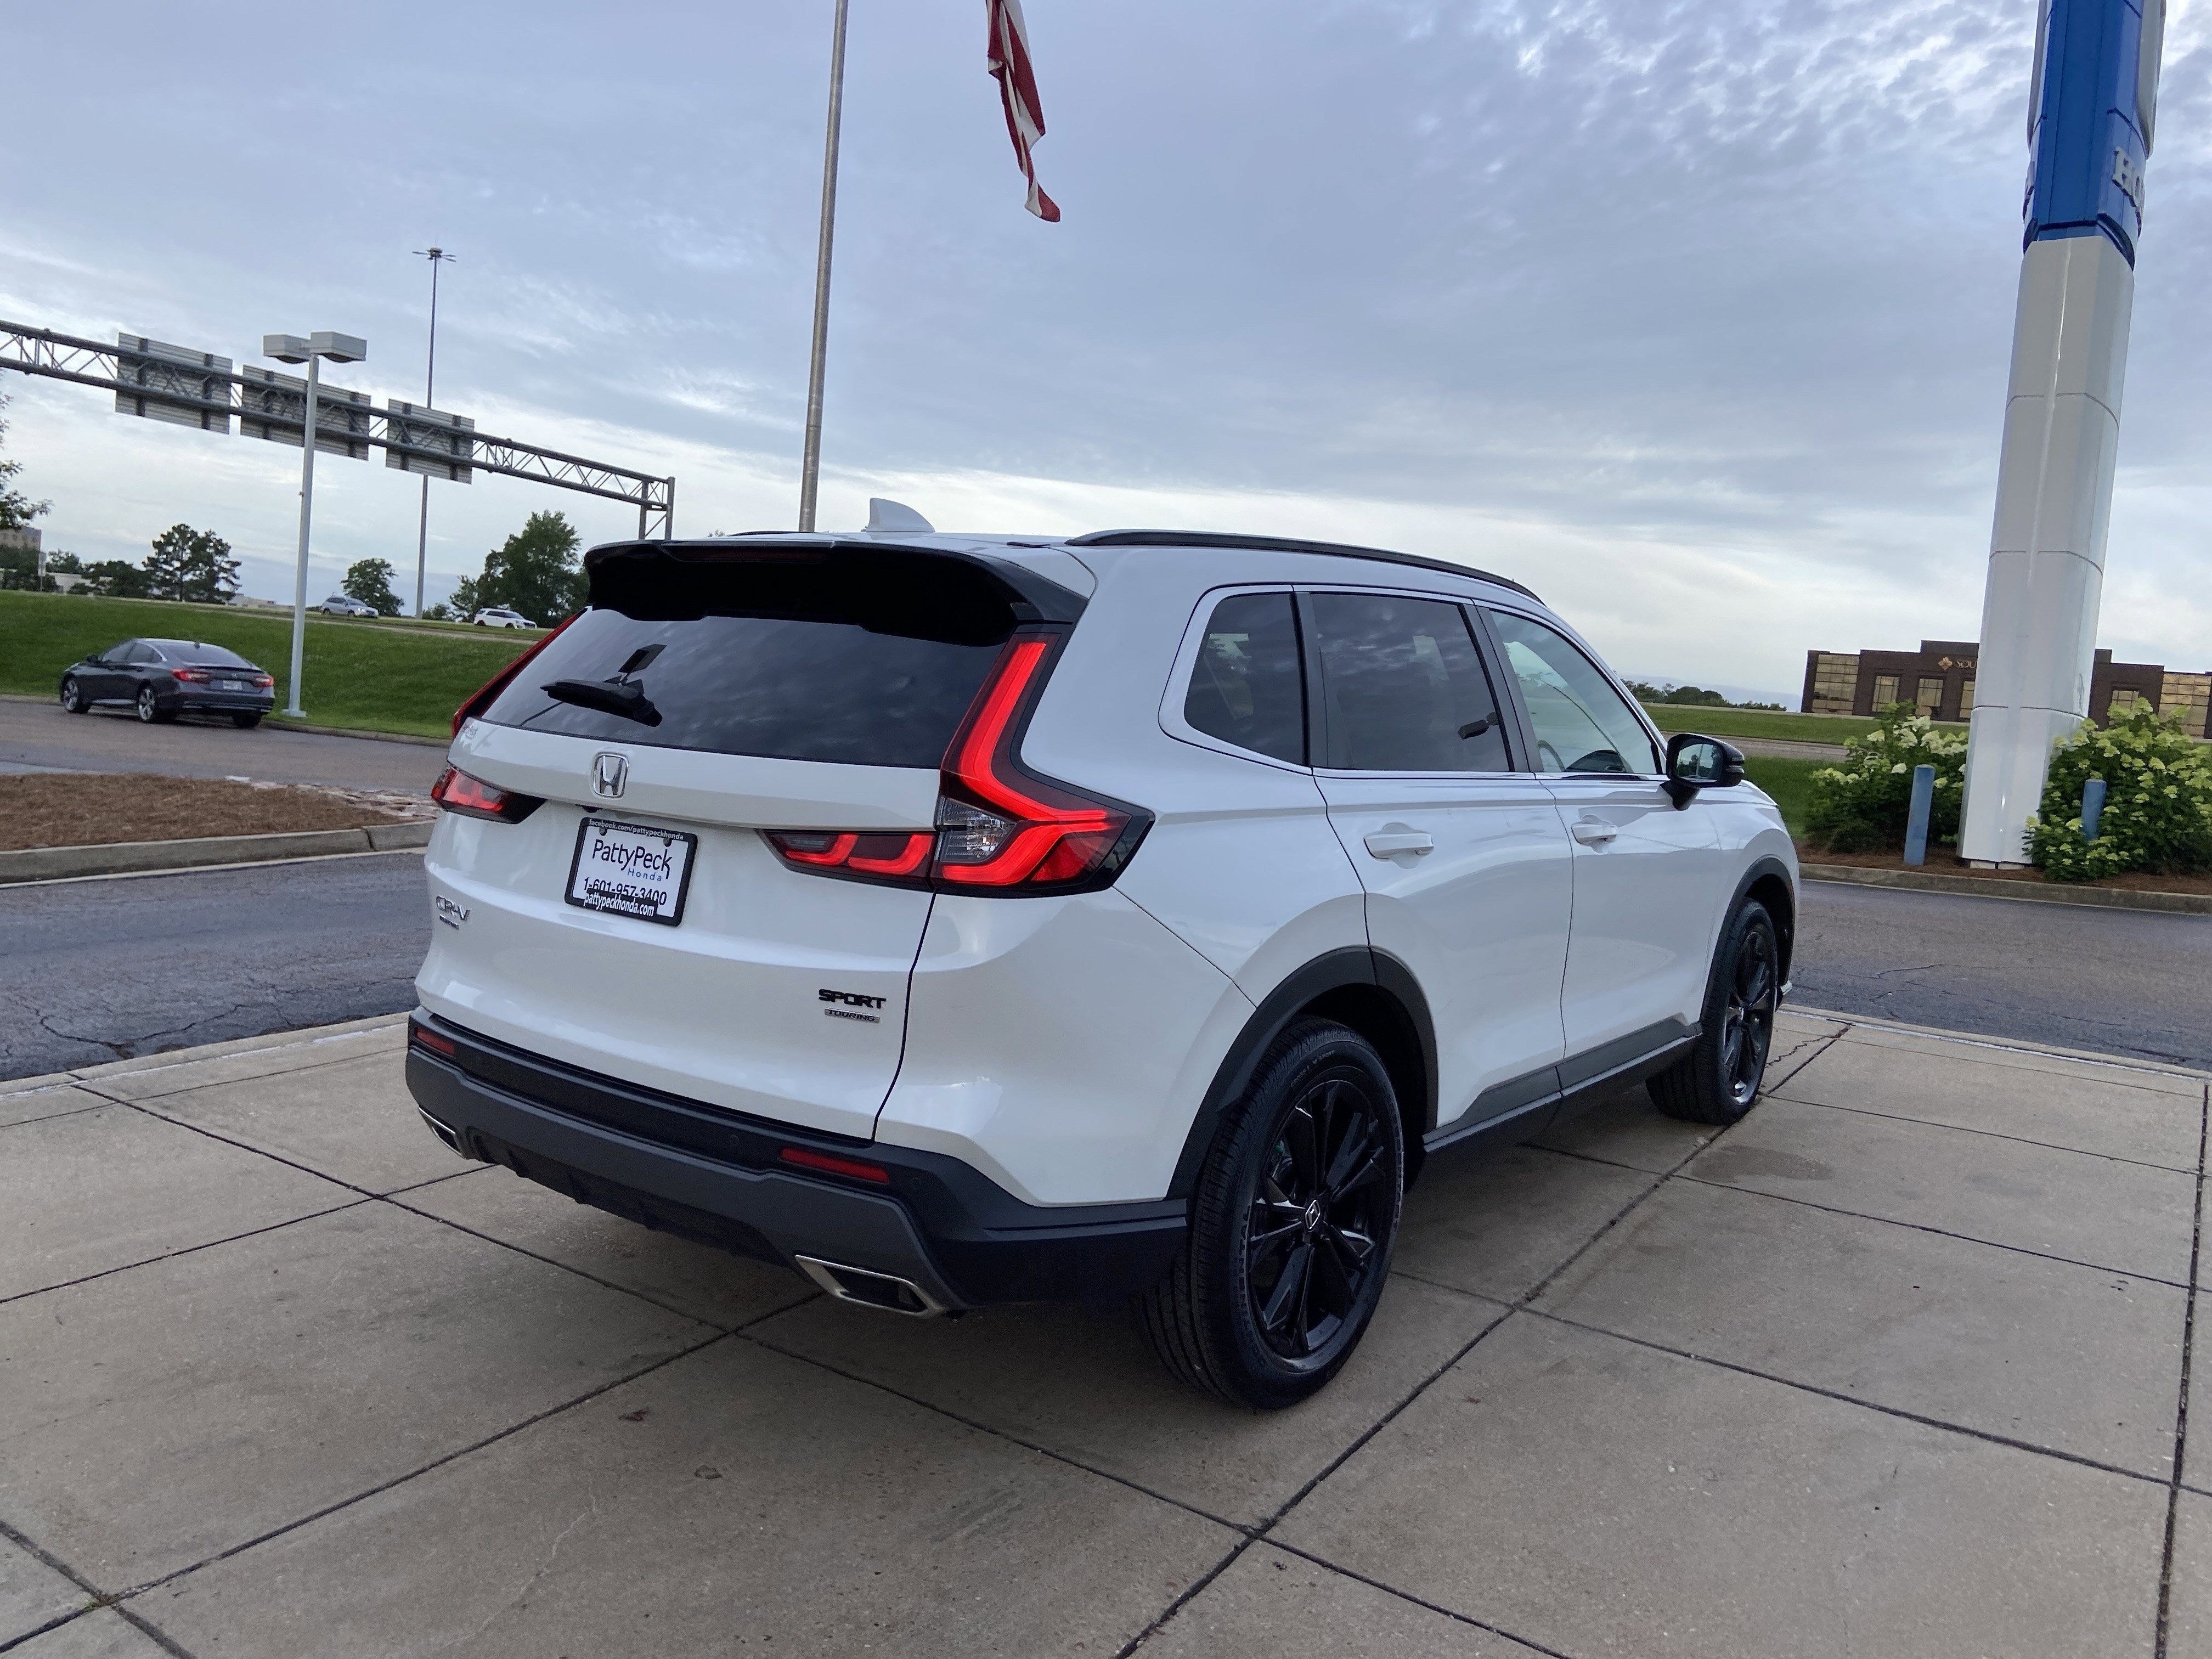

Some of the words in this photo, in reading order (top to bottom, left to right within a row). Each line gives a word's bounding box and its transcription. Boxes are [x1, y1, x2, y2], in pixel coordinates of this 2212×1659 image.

[589, 819, 684, 840] facebook.com/pattypeckhonda
[592, 839, 673, 879] PattyPeck
[628, 867, 663, 882] Honda
[583, 893, 654, 917] pattypeckhonda.com
[819, 989, 887, 1009] SPORT
[829, 1011, 875, 1022] TOURING
